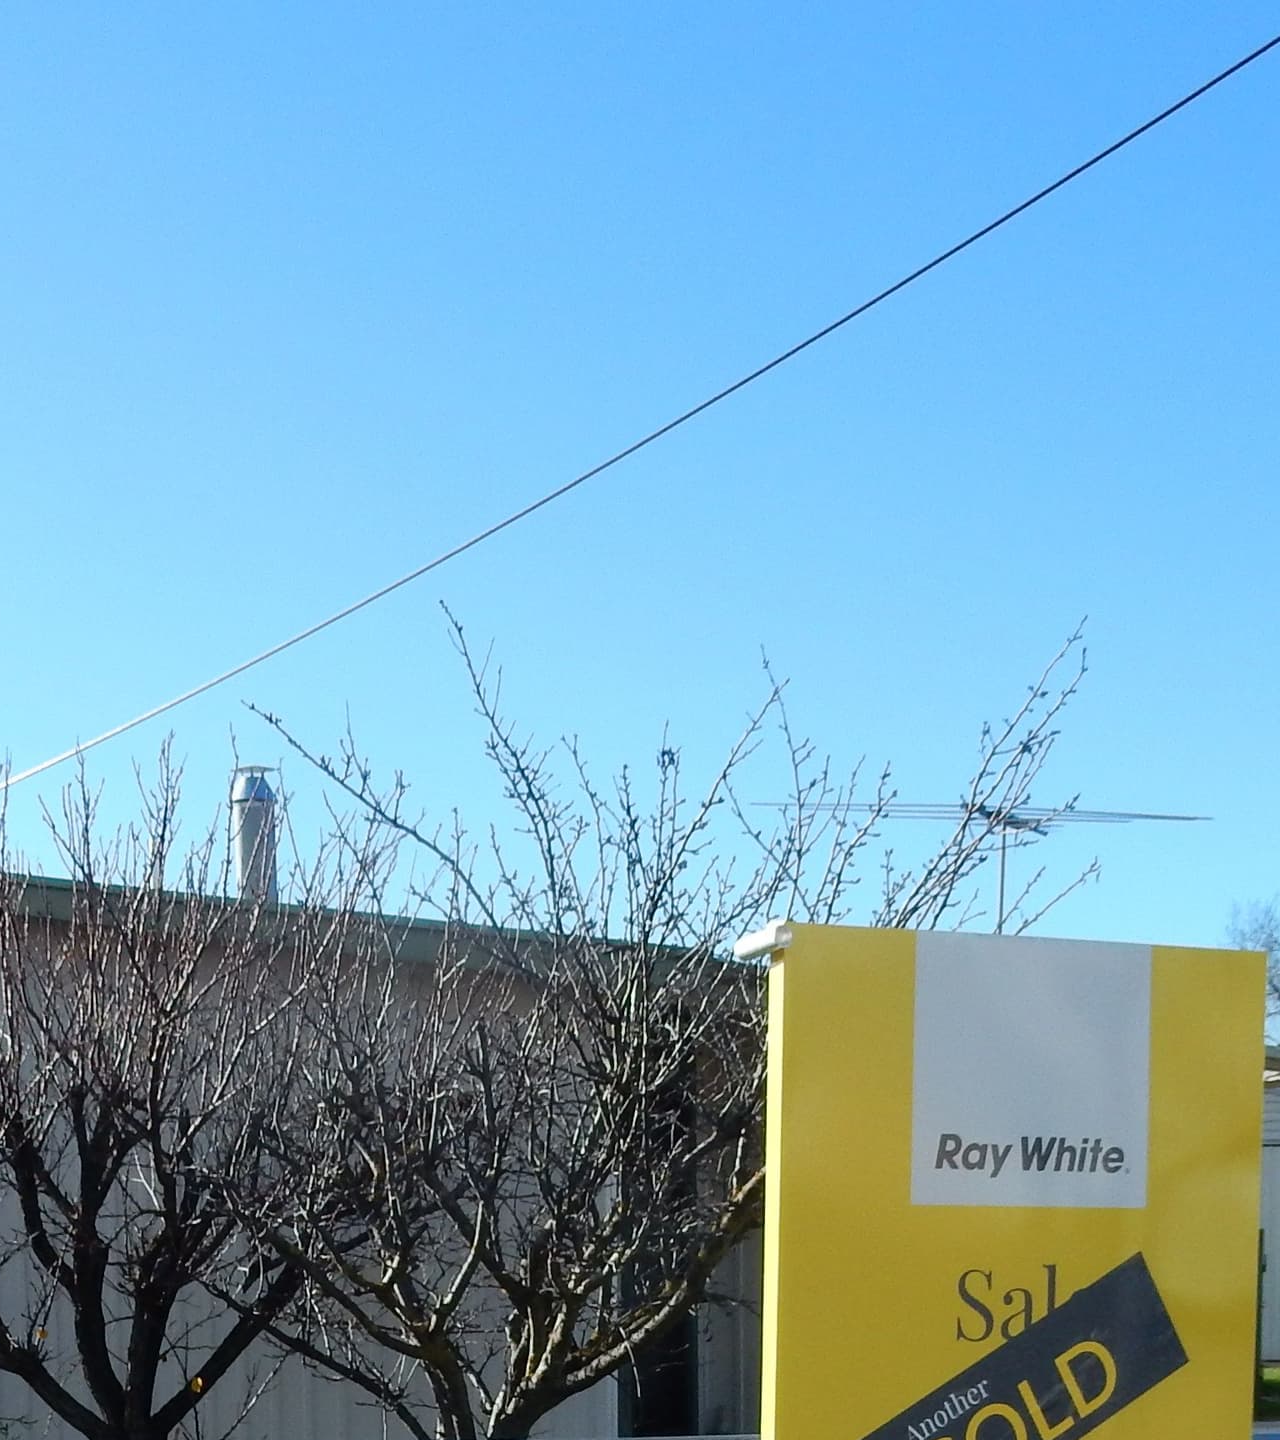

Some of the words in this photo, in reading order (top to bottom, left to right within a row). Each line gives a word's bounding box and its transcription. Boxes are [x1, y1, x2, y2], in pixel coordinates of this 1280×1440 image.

[935, 1133, 1013, 1178] Ray
[1021, 1136, 1124, 1174] White
[956, 1264, 1087, 1342] Sal
